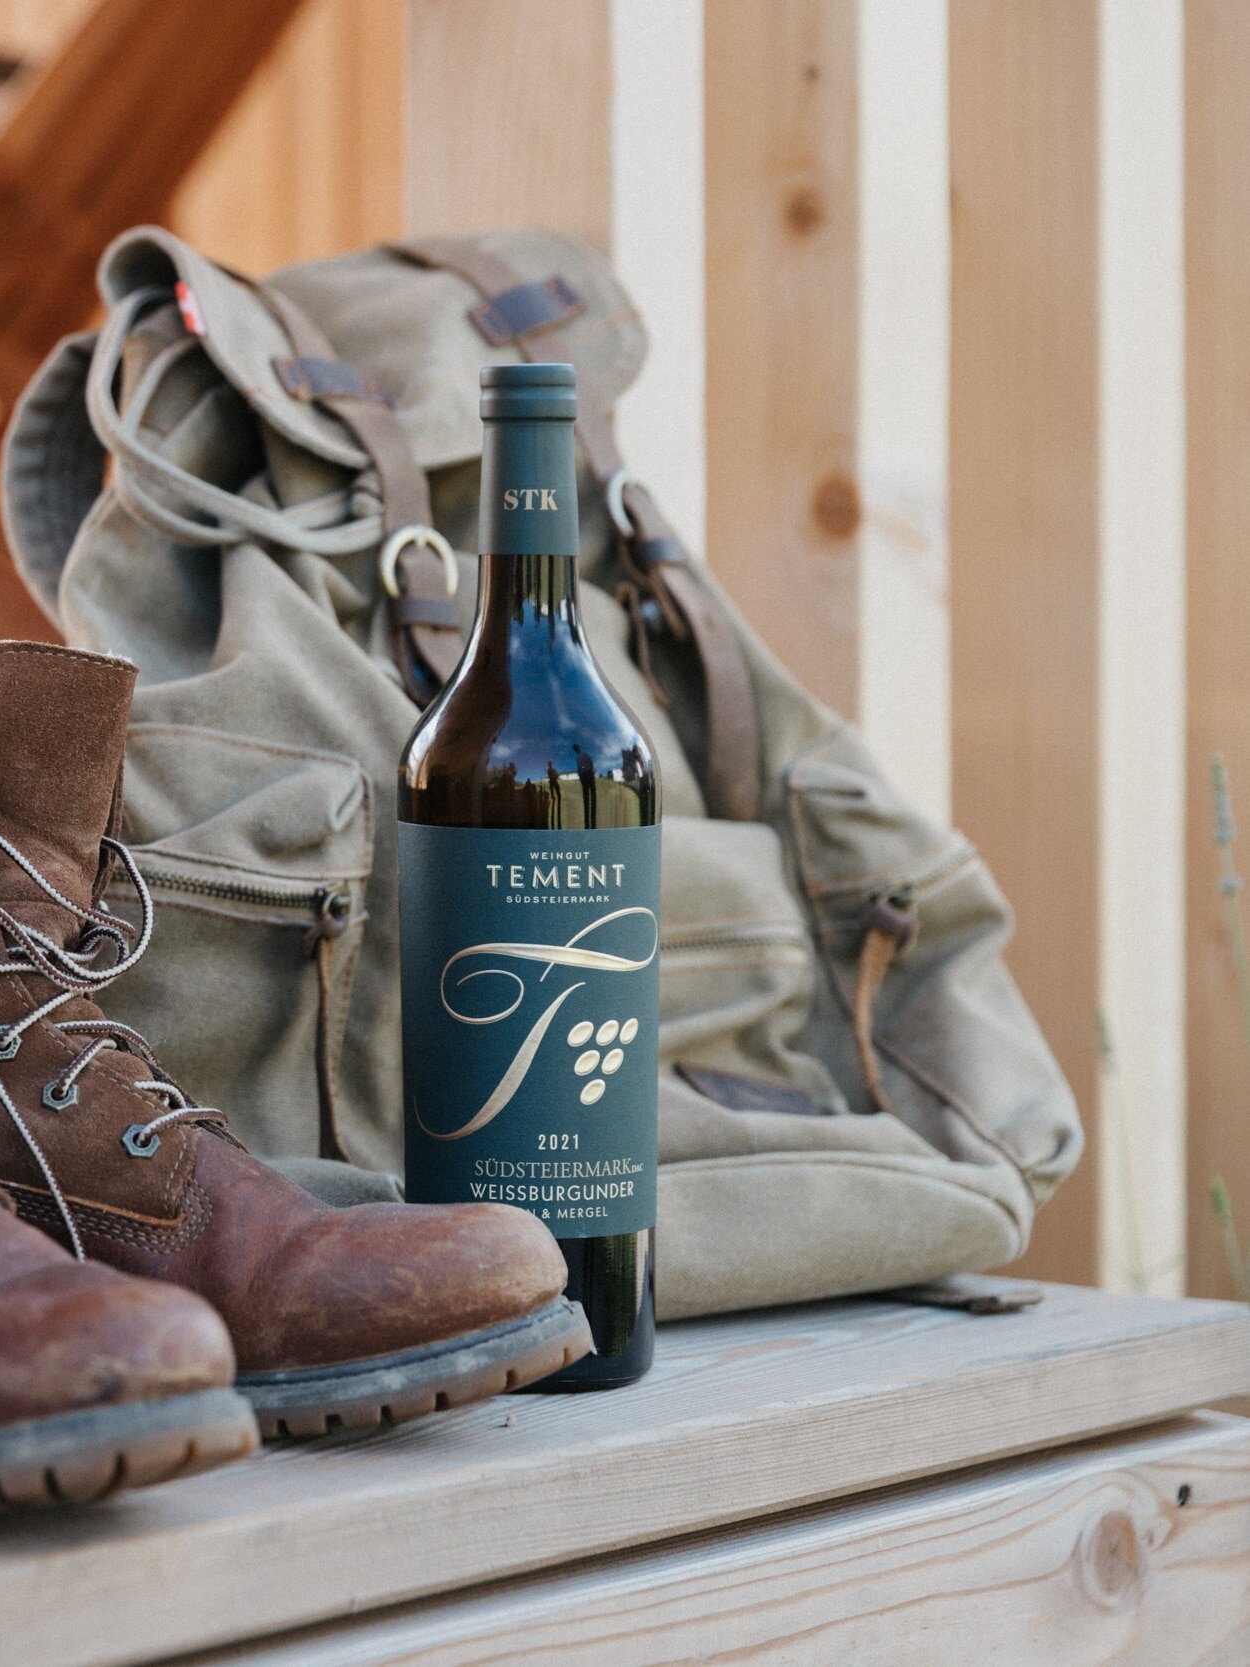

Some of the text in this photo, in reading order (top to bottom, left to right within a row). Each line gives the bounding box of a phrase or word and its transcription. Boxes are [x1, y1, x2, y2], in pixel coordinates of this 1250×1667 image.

[504, 489, 558, 510] STK
[530, 851, 590, 860] WEINGUT
[486, 864, 626, 889] TEMENT
[506, 895, 610, 904] SÜDSTEIERMARK
[538, 1134, 579, 1150] 2021
[475, 1157, 631, 1179] SÜDSTEIERMARK
[470, 1181, 634, 1202] WEISSBURGUNDER
[541, 1209, 551, 1220] &
[557, 1206, 608, 1219] MERGEL
